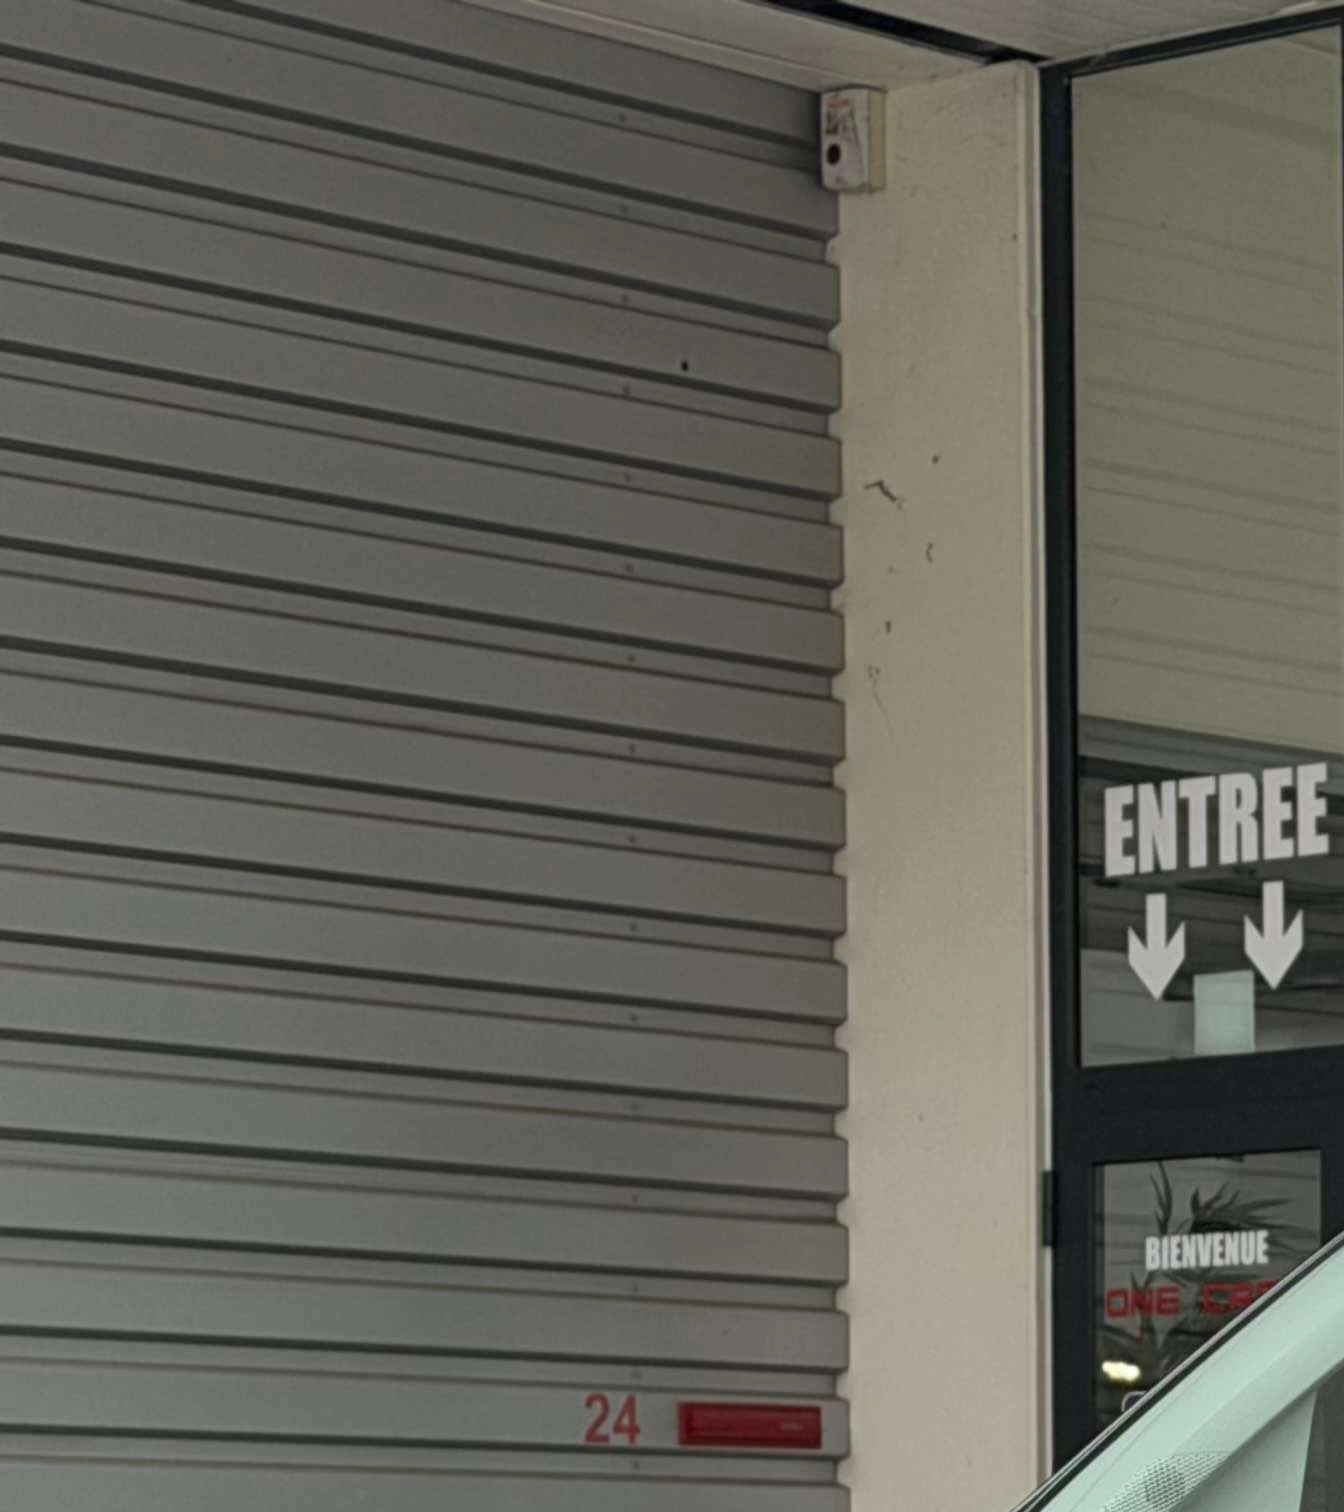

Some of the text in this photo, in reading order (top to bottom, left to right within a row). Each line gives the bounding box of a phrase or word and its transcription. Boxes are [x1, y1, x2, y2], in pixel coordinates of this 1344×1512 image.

[1104, 762, 1330, 878] ENTREE
[1145, 1229, 1269, 1271] BIENVENUE
[1105, 1285, 1181, 1319] ONE
[583, 1393, 641, 1445] 24
